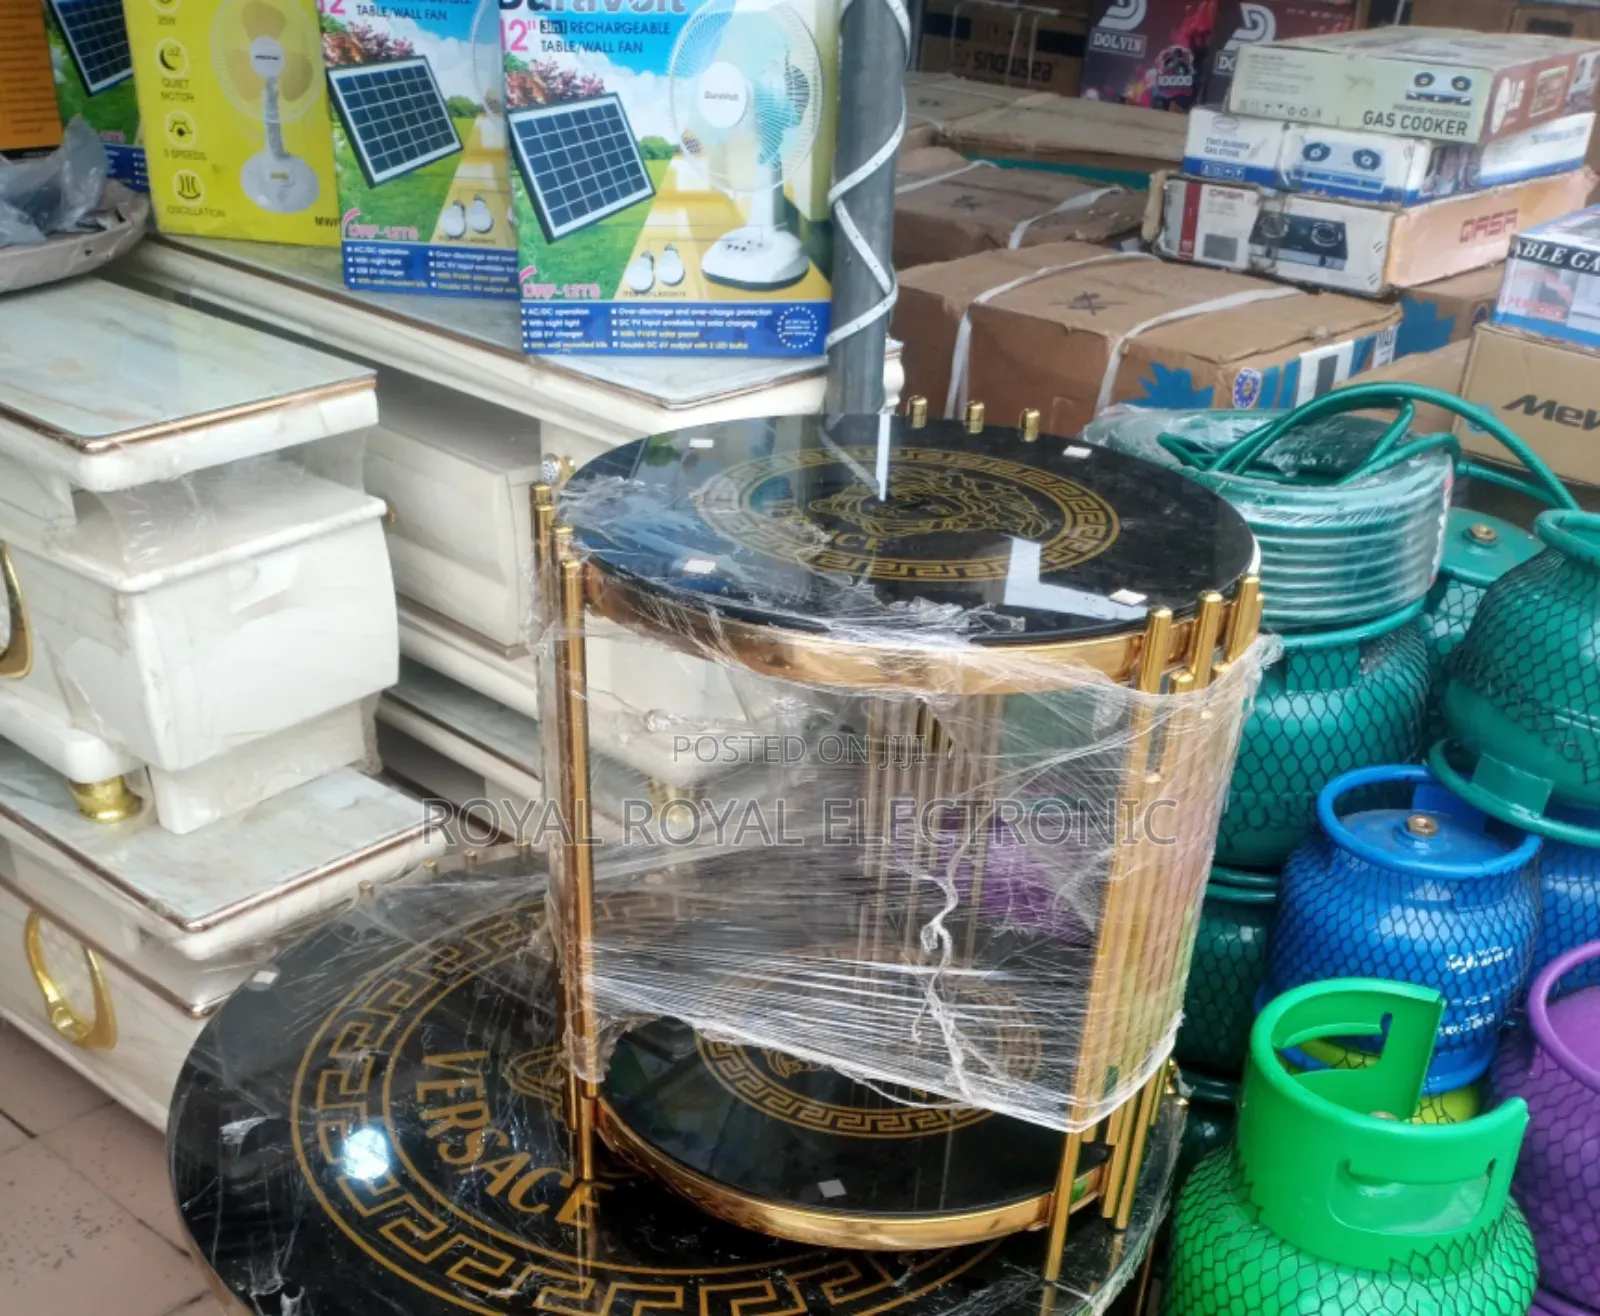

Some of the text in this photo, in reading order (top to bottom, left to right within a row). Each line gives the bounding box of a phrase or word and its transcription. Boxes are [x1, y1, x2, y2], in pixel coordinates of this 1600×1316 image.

[356, 5, 448, 21] TABLE/WALL FAN
[570, 21, 671, 35] RECHARGEABLE
[541, 40, 643, 54] TABLE/WALL FAN
[1094, 33, 1143, 52] DOLVIN
[161, 78, 189, 89] QUIET
[160, 90, 195, 103] MOTOR
[1363, 110, 1468, 137] GAS COOKER
[166, 205, 227, 219] OSCILLATION
[415, 1049, 616, 1229] VERSACE
